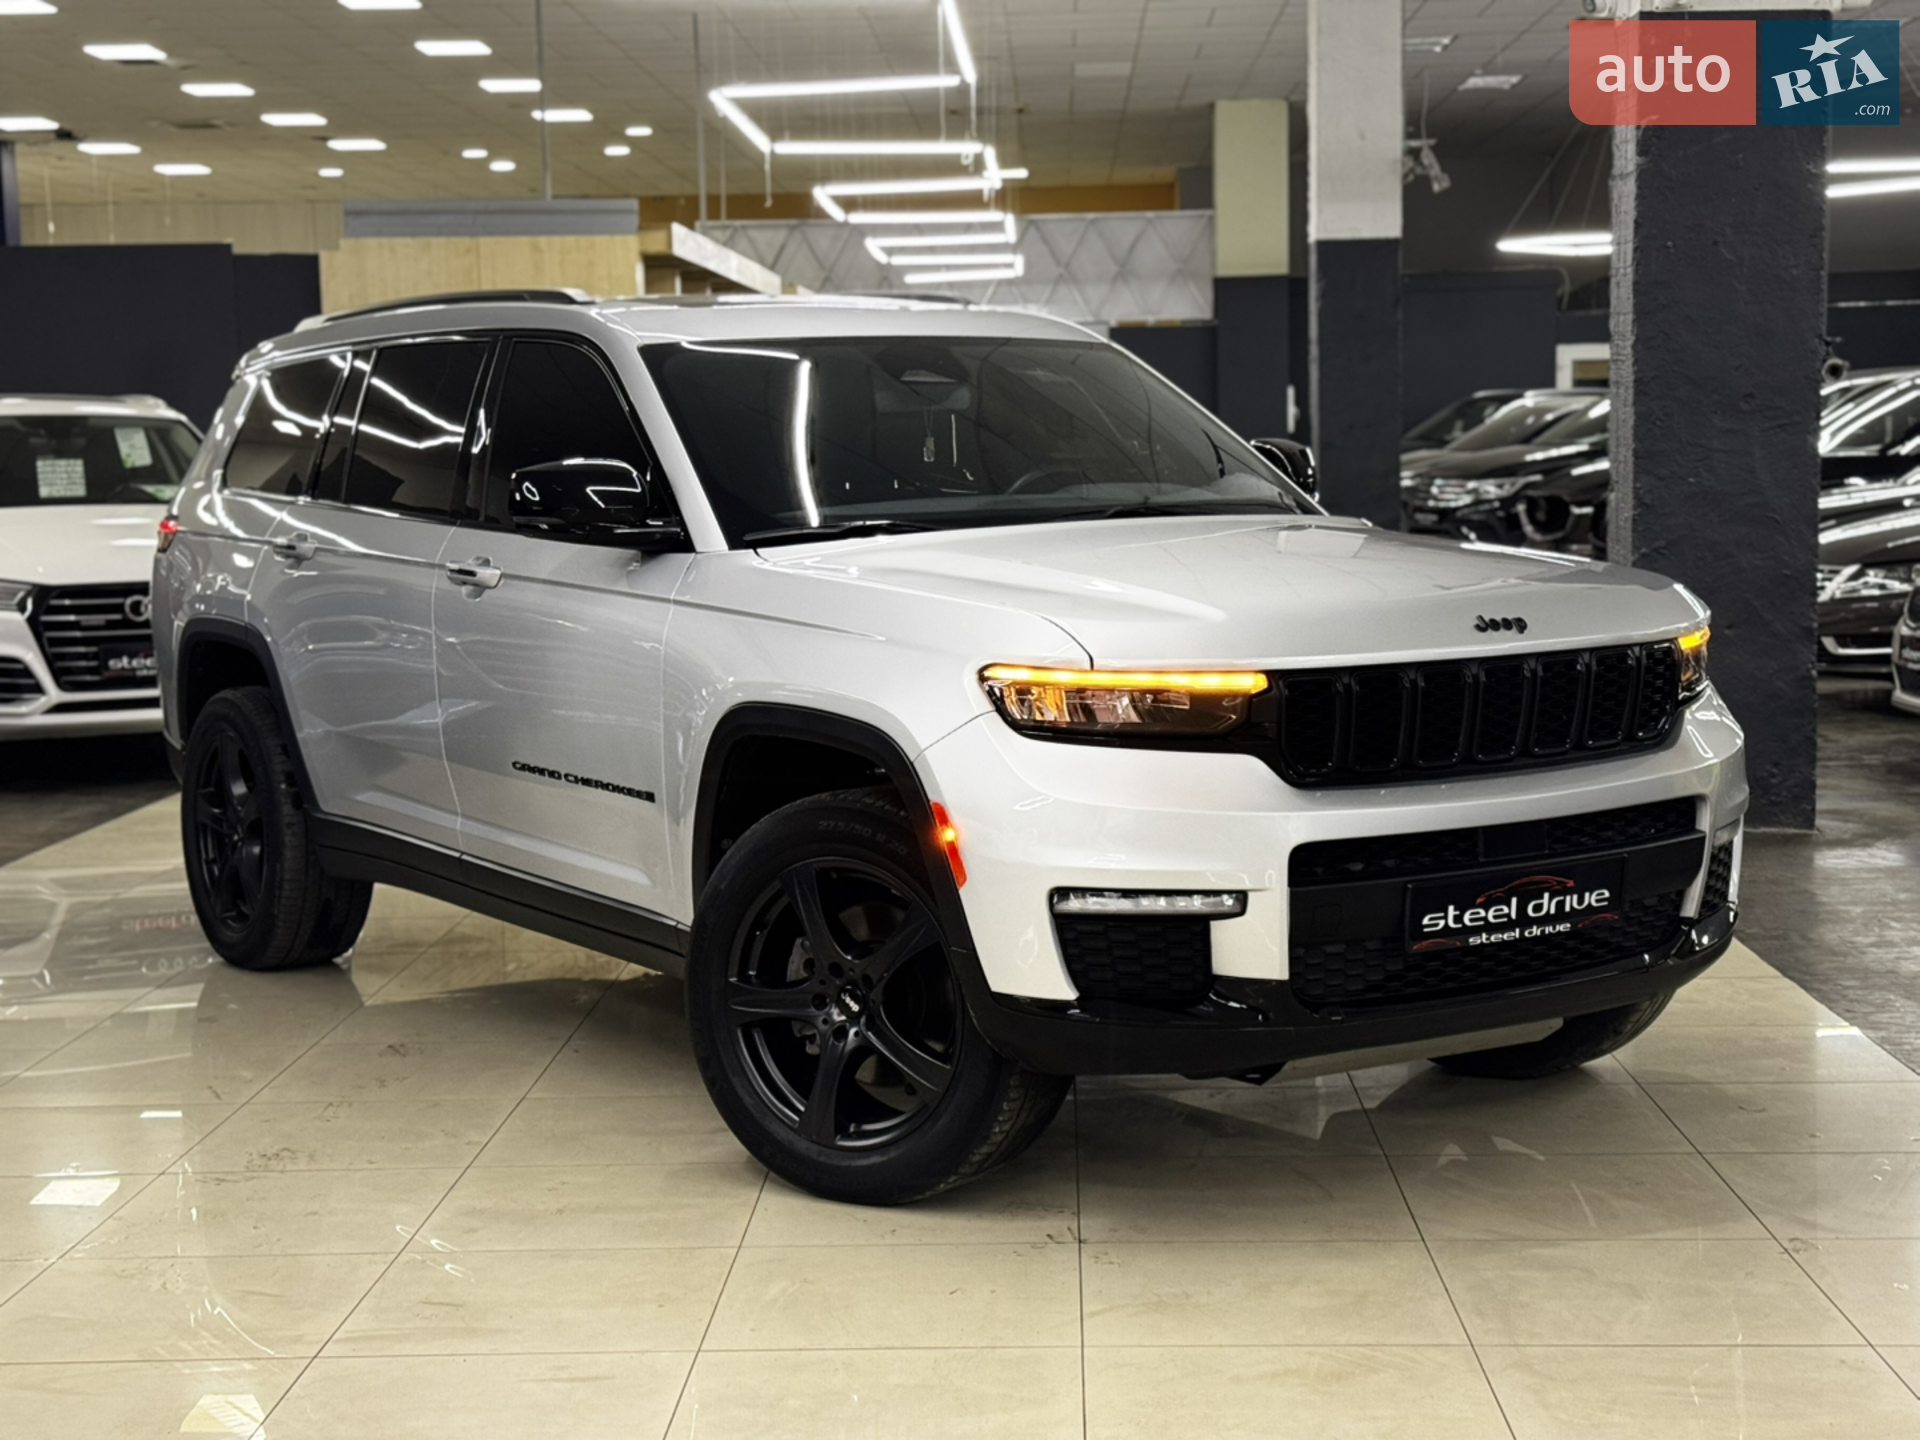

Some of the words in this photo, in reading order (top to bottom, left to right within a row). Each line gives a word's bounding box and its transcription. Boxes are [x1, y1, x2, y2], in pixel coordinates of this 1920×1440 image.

[1473, 614, 1528, 635] Jeep
[511, 760, 562, 780] GRAND
[818, 820, 873, 837] 275/50
[1421, 896, 1518, 932] steel
[1527, 888, 1611, 918] drive
[1468, 928, 1520, 946] steel
[1524, 922, 1572, 938] drive
